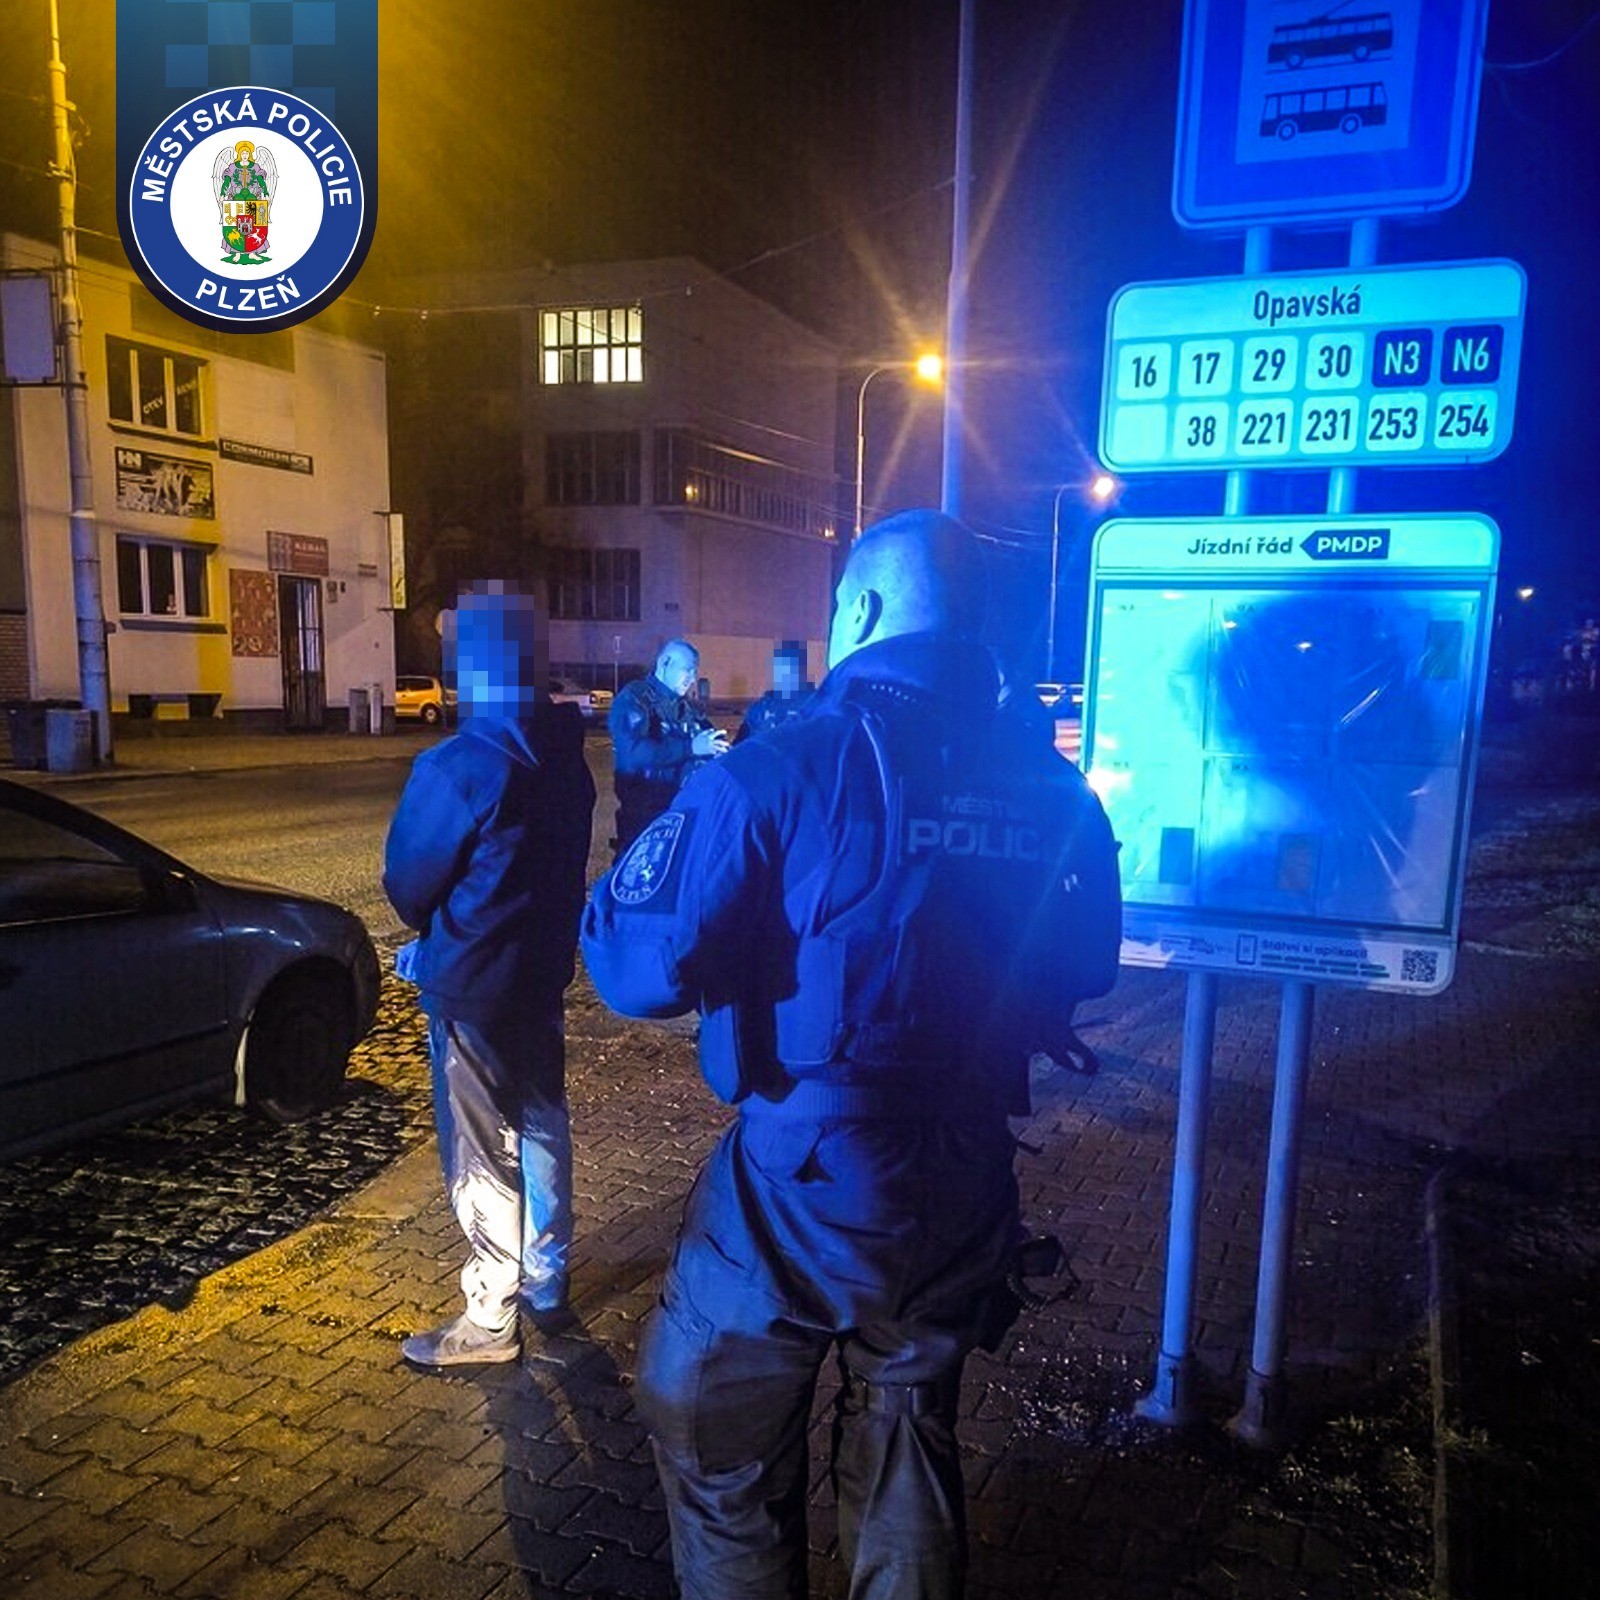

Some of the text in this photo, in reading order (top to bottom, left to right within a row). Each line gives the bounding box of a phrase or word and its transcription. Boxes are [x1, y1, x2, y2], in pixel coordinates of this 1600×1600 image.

[1253, 285, 1361, 327] Opavská
[1131, 336, 1490, 388] 16 17 29 30 N3 N6
[1186, 404, 1490, 447] 38 221 231 253 254
[1187, 535, 1383, 556] Jízdní řád PMDP
[908, 817, 1046, 862] POLIC
